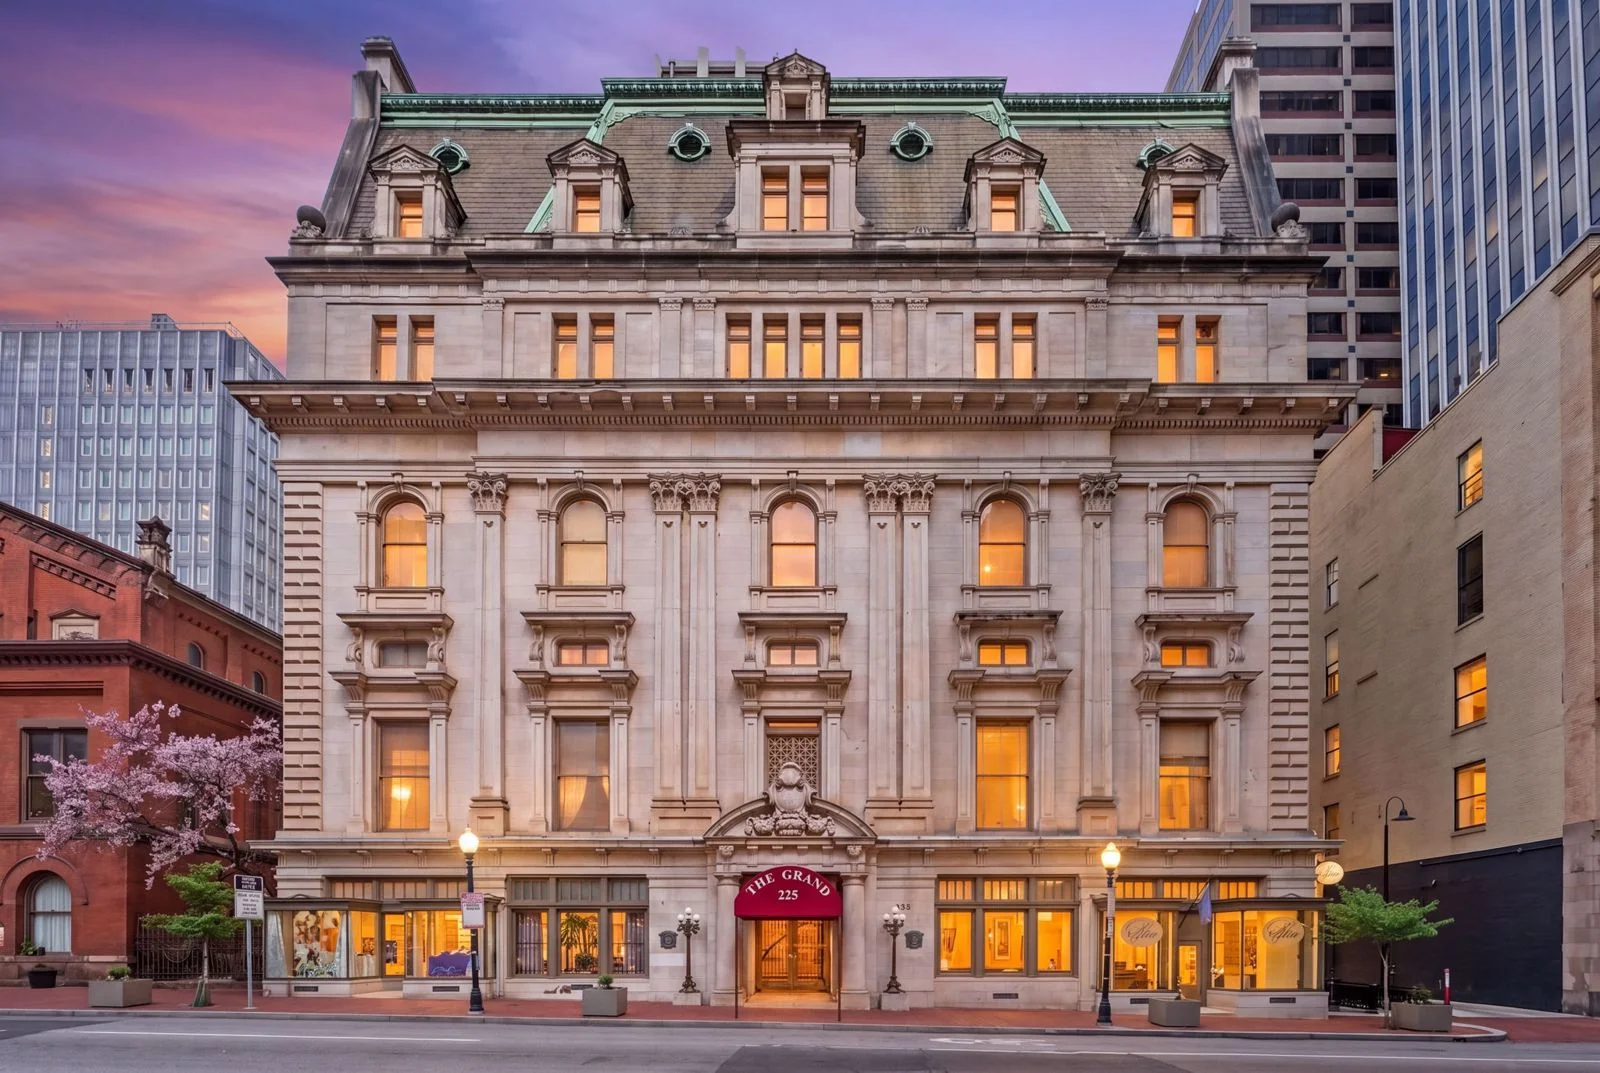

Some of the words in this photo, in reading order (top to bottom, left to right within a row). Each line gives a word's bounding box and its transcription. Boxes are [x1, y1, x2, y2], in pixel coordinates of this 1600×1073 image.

[745, 873, 775, 896] THE
[782, 869, 831, 897] GRAND
[778, 889, 799, 901] 225
